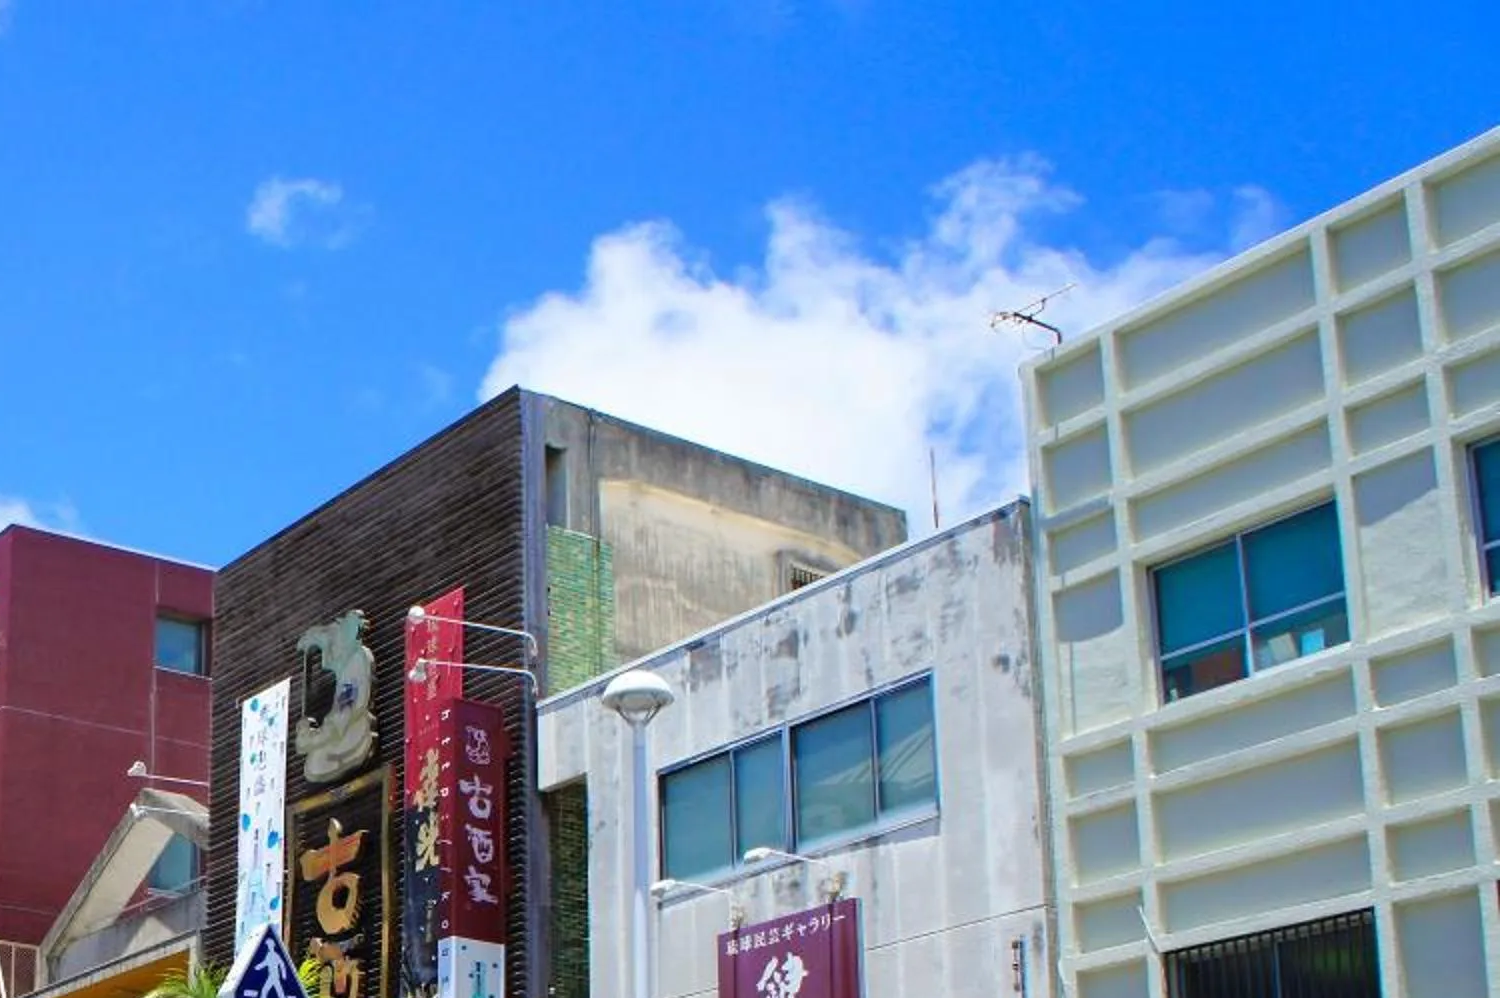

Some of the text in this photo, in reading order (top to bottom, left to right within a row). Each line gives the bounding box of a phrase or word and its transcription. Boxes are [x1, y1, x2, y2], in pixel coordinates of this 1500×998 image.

[725, 914, 847, 956] 琉球民芸ギャラリー
